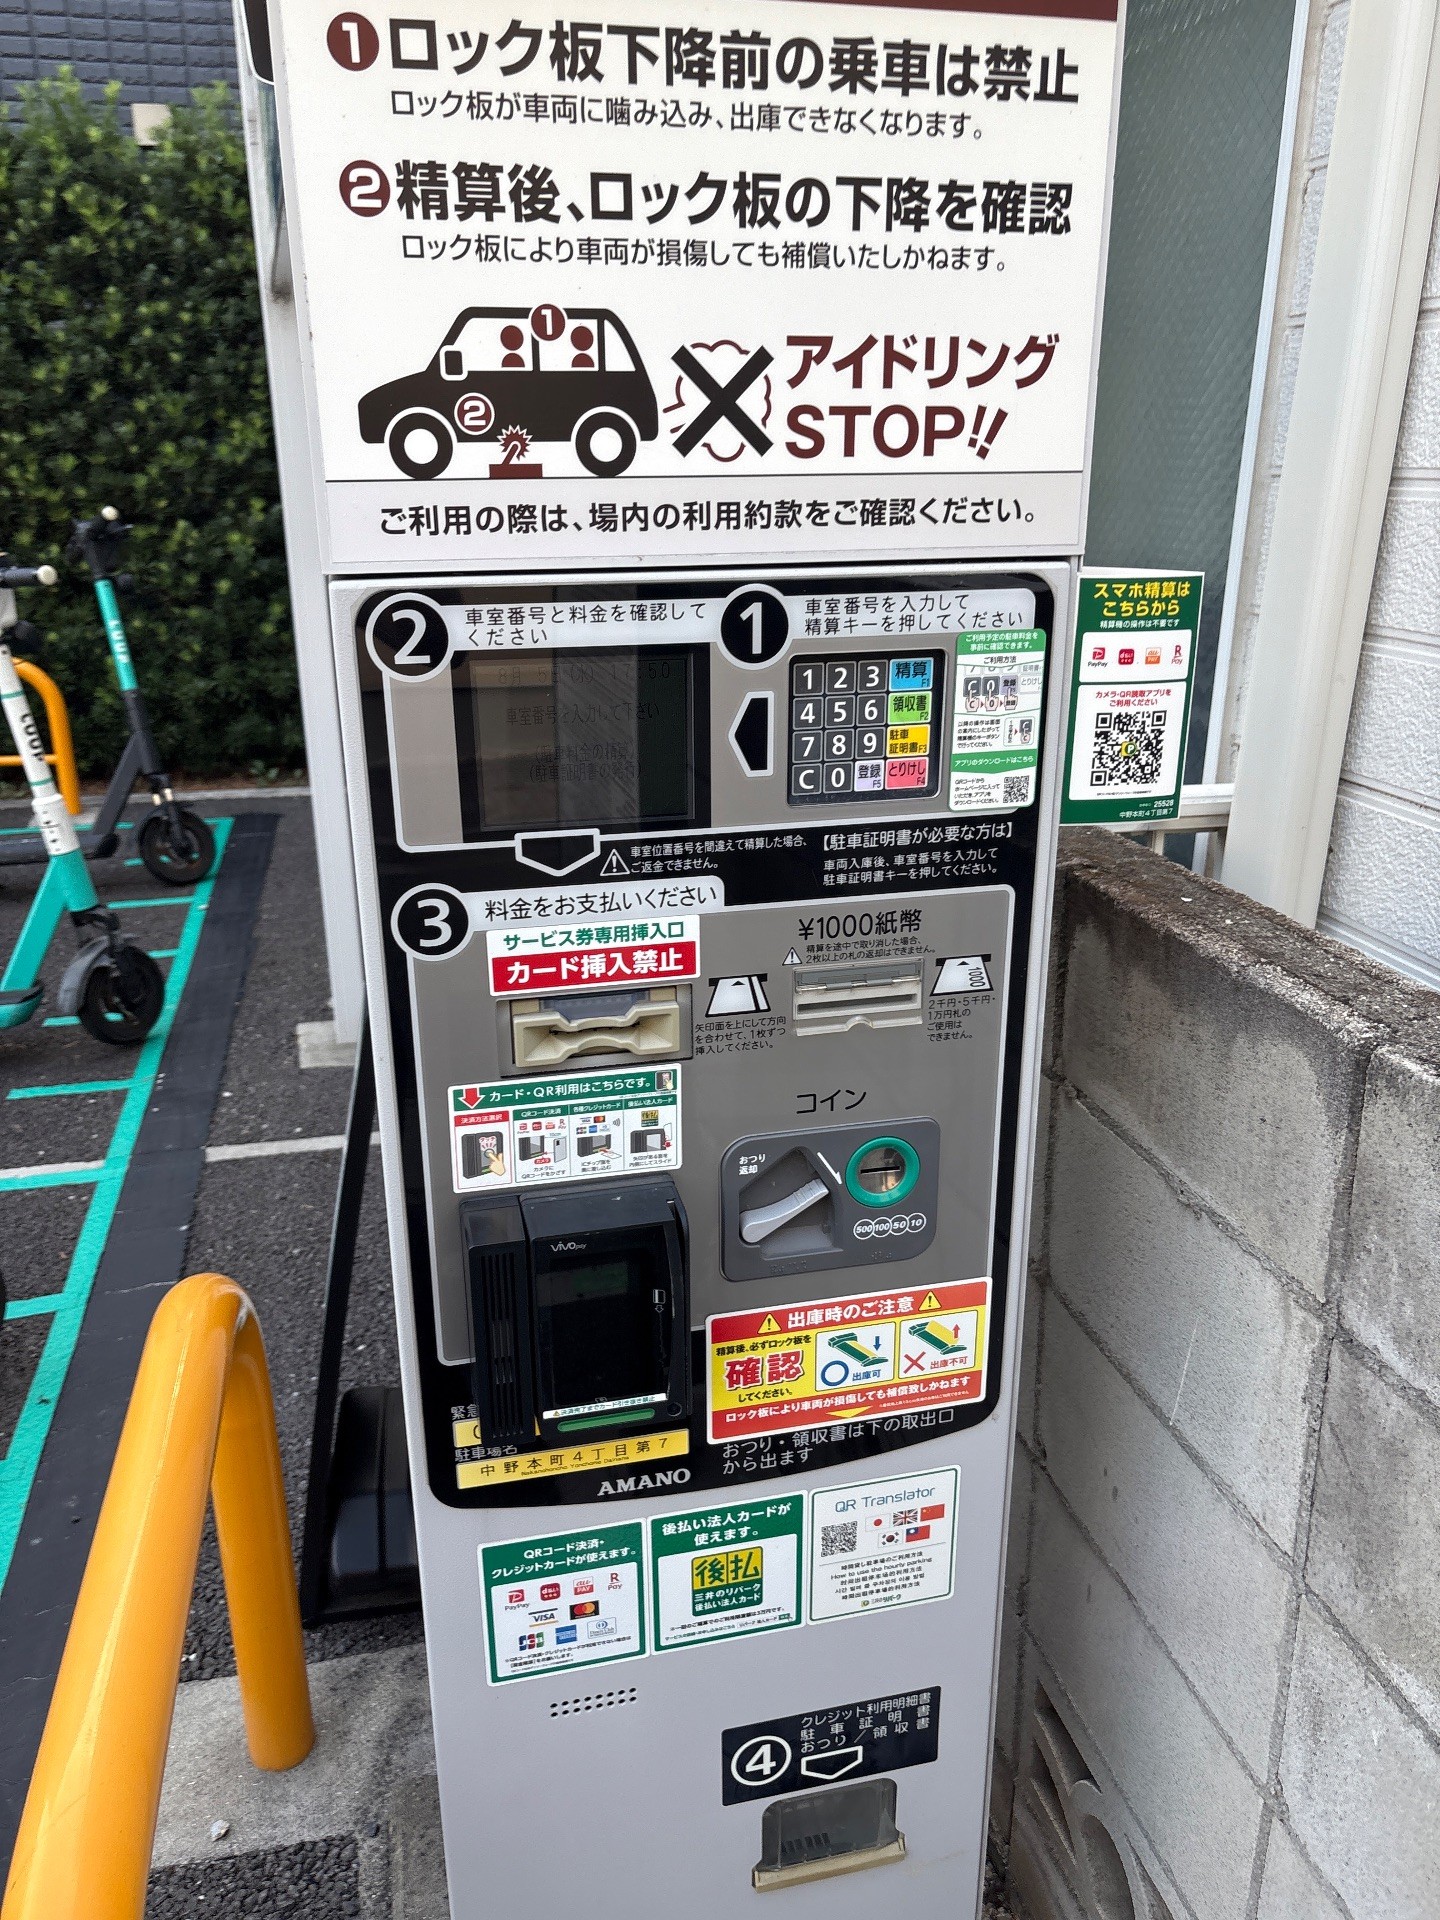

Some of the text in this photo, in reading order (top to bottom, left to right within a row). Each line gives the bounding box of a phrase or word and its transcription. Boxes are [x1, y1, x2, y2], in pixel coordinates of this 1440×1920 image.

[390, 18, 1079, 104] ロック板下降前の乗車は禁止
[392, 89, 983, 140] ロック板が車両に噛み込み、出庫できなくなります。
[395, 160, 1071, 235] 精算後、ロック板の下降を確認
[403, 235, 1006, 272] ロック板により車両が損傷しても補償いたしかねます。
[786, 334, 1061, 389] アイドリング
[786, 404, 1009, 460] STOP!!
[381, 497, 1036, 536] ご利用の際は、場内の利用約款をご確認ください。
[1094, 581, 1190, 599] スマホ精算は
[465, 601, 706, 626] 車室番号と料金を確認して
[805, 594, 969, 616] 車室番号を入力して
[1103, 600, 1180, 617] こちらから
[805, 612, 1023, 635] 精算キーを押してください
[1100, 618, 1179, 629] 精算機の操作は不要です
[392, 609, 431, 665] 2
[468, 628, 548, 646] ください
[803, 669, 812, 690] 1
[834, 668, 848, 688] 2
[866, 666, 879, 687] 3
[895, 661, 927, 679] 精算
[922, 679, 930, 687] F1
[800, 703, 815, 723] 4
[834, 701, 846, 722] 5
[864, 700, 878, 720] 6
[893, 695, 927, 712] 領収書
[1110, 699, 1157, 707] ご利用ください
[920, 712, 928, 720] F2
[863, 733, 876, 753] 9
[890, 729, 909, 740] 駐車
[802, 737, 814, 757] 7
[832, 735, 846, 755] 8
[889, 744, 918, 754] 証明書
[889, 762, 925, 776] とりけし
[955, 756, 1034, 767] アプリのダウンロードはこちら
[799, 770, 814, 789] C
[858, 765, 880, 779] 登録
[917, 777, 925, 785] F4
[630, 836, 807, 858] 車室位置番号を間違えて精算した場合、
[821, 822, 1014, 852] 【駐車証明書が必要な方は】
[630, 857, 719, 873] ご返金できません。
[824, 847, 998, 871] 車両入庫後、車室番号を入力して
[823, 863, 999, 887] 駐車証明書キーを押してください。
[485, 884, 717, 922] 料金をお支払いください
[416, 898, 452, 948] 3
[798, 908, 922, 940] ¥1000紙幣
[503, 921, 684, 951] サービス券専用挿入口
[806, 936, 922, 953] 精算を途中で取り消した場合、
[506, 947, 684, 984] カード挿入禁止
[805, 946, 936, 965] 2枚以上の札の返却はできません。
[695, 1016, 787, 1032] 矢印面を上にして方向
[927, 1008, 971, 1020] 1万円札の
[695, 1027, 786, 1044] を合わせて、1枚ずつ
[927, 1020, 963, 1031] ご使用は
[927, 1031, 973, 1042] できません。
[695, 1040, 773, 1056] 挿入してください。
[490, 1077, 650, 1101] カード・QR利用はこちらです。
[796, 1088, 867, 1115] コイン
[739, 1153, 766, 1164] おつり
[739, 1165, 758, 1175] 返却
[788, 1296, 915, 1328] 出庫時のご注意
[716, 1332, 812, 1357] 精算後、必ずロック板を
[724, 1349, 804, 1391] 確認
[930, 1356, 968, 1370] 出庫不可
[852, 1369, 882, 1382] 出庫可
[726, 1377, 970, 1423] ロック板により車両が損傷しても補償致しかねます
[738, 1387, 793, 1402] してください。
[723, 1409, 954, 1459] おつり・領収書は下の取出口
[723, 1447, 813, 1475] から出ます
[597, 1468, 691, 1497] AMANO
[835, 1487, 935, 1513] QR Translator
[662, 1502, 792, 1536] 後払い法人カードが
[694, 1526, 758, 1546] 使えます。
[491, 1547, 636, 1579] クレジットカードが使えます。
[695, 1552, 760, 1586] 後払
[694, 1583, 761, 1601] 三井のリパーク
[694, 1593, 761, 1611] 後払い法人カード
[505, 1603, 530, 1611] PayPay
[533, 1613, 555, 1623] VISA
[801, 1692, 931, 1728] クレジット利用明細書
